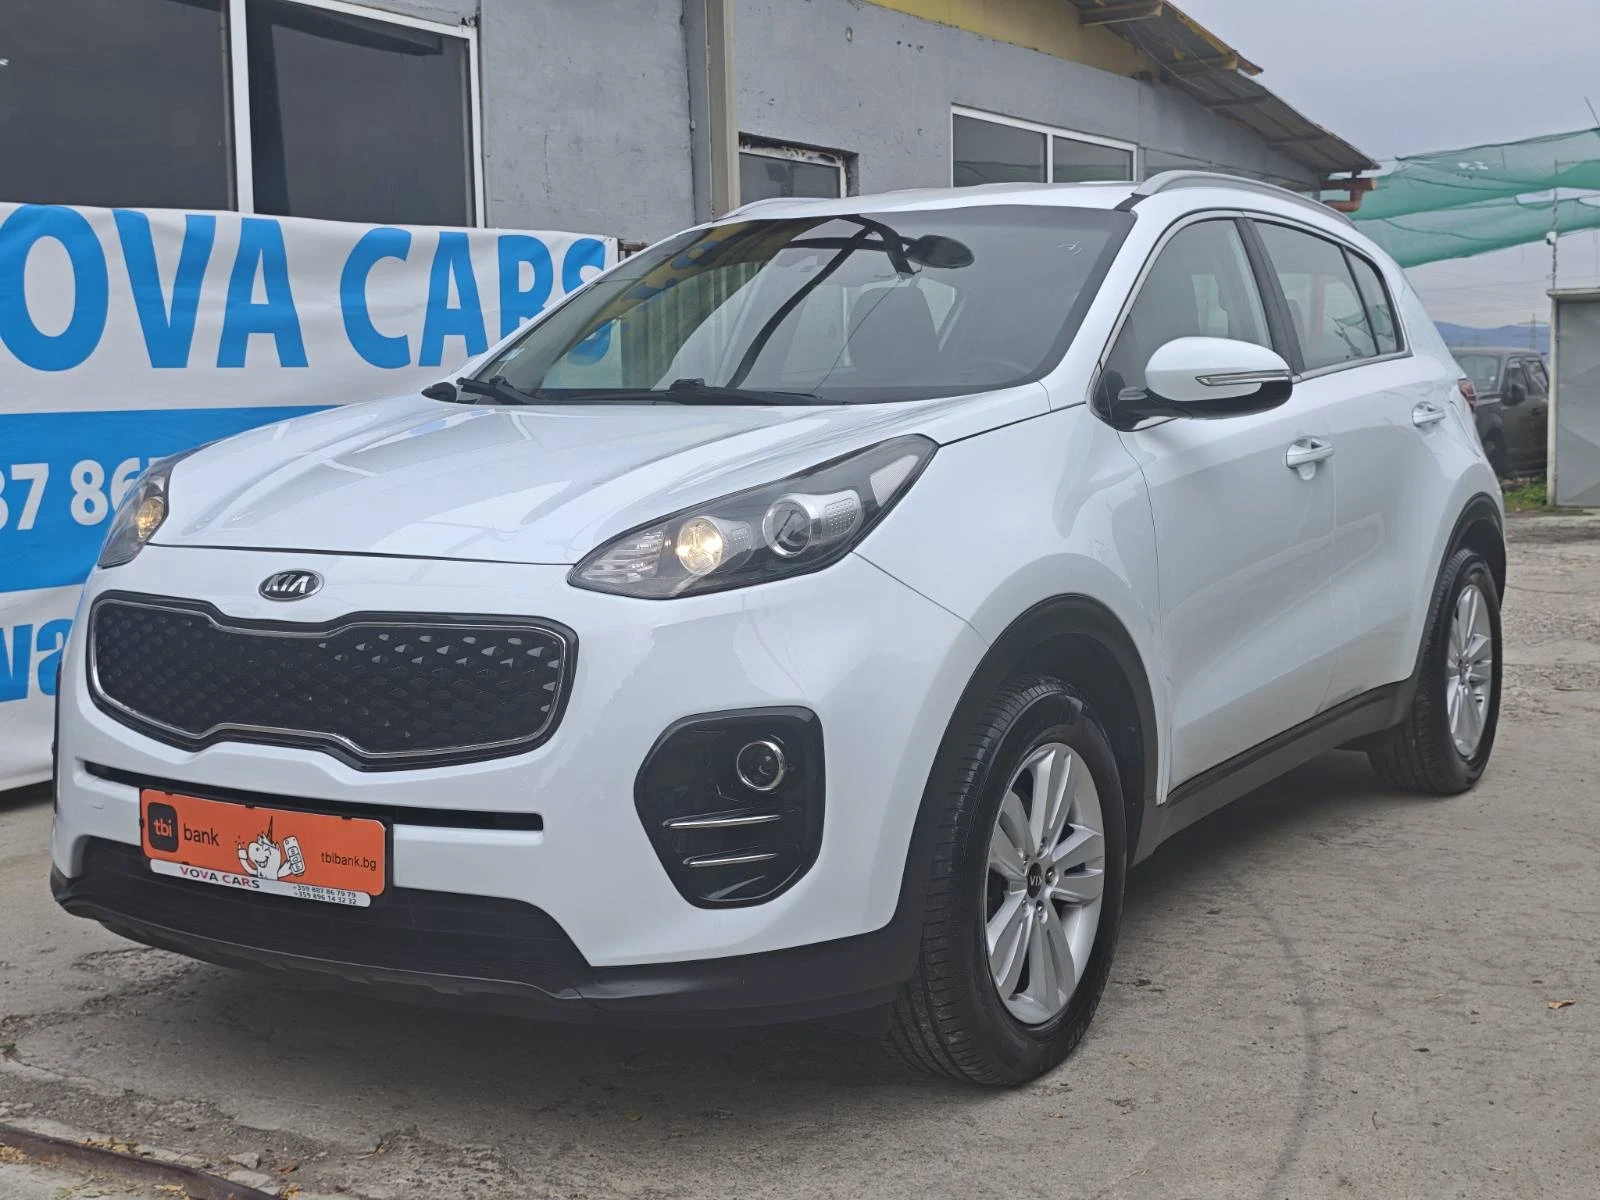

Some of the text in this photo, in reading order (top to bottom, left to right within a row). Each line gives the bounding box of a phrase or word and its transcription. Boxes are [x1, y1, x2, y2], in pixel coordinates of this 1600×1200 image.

[264, 574, 311, 594] KIA
[153, 818, 219, 847] tbi bank
[321, 851, 377, 872] tbibank.bg
[180, 866, 260, 889] VOVA CARS
